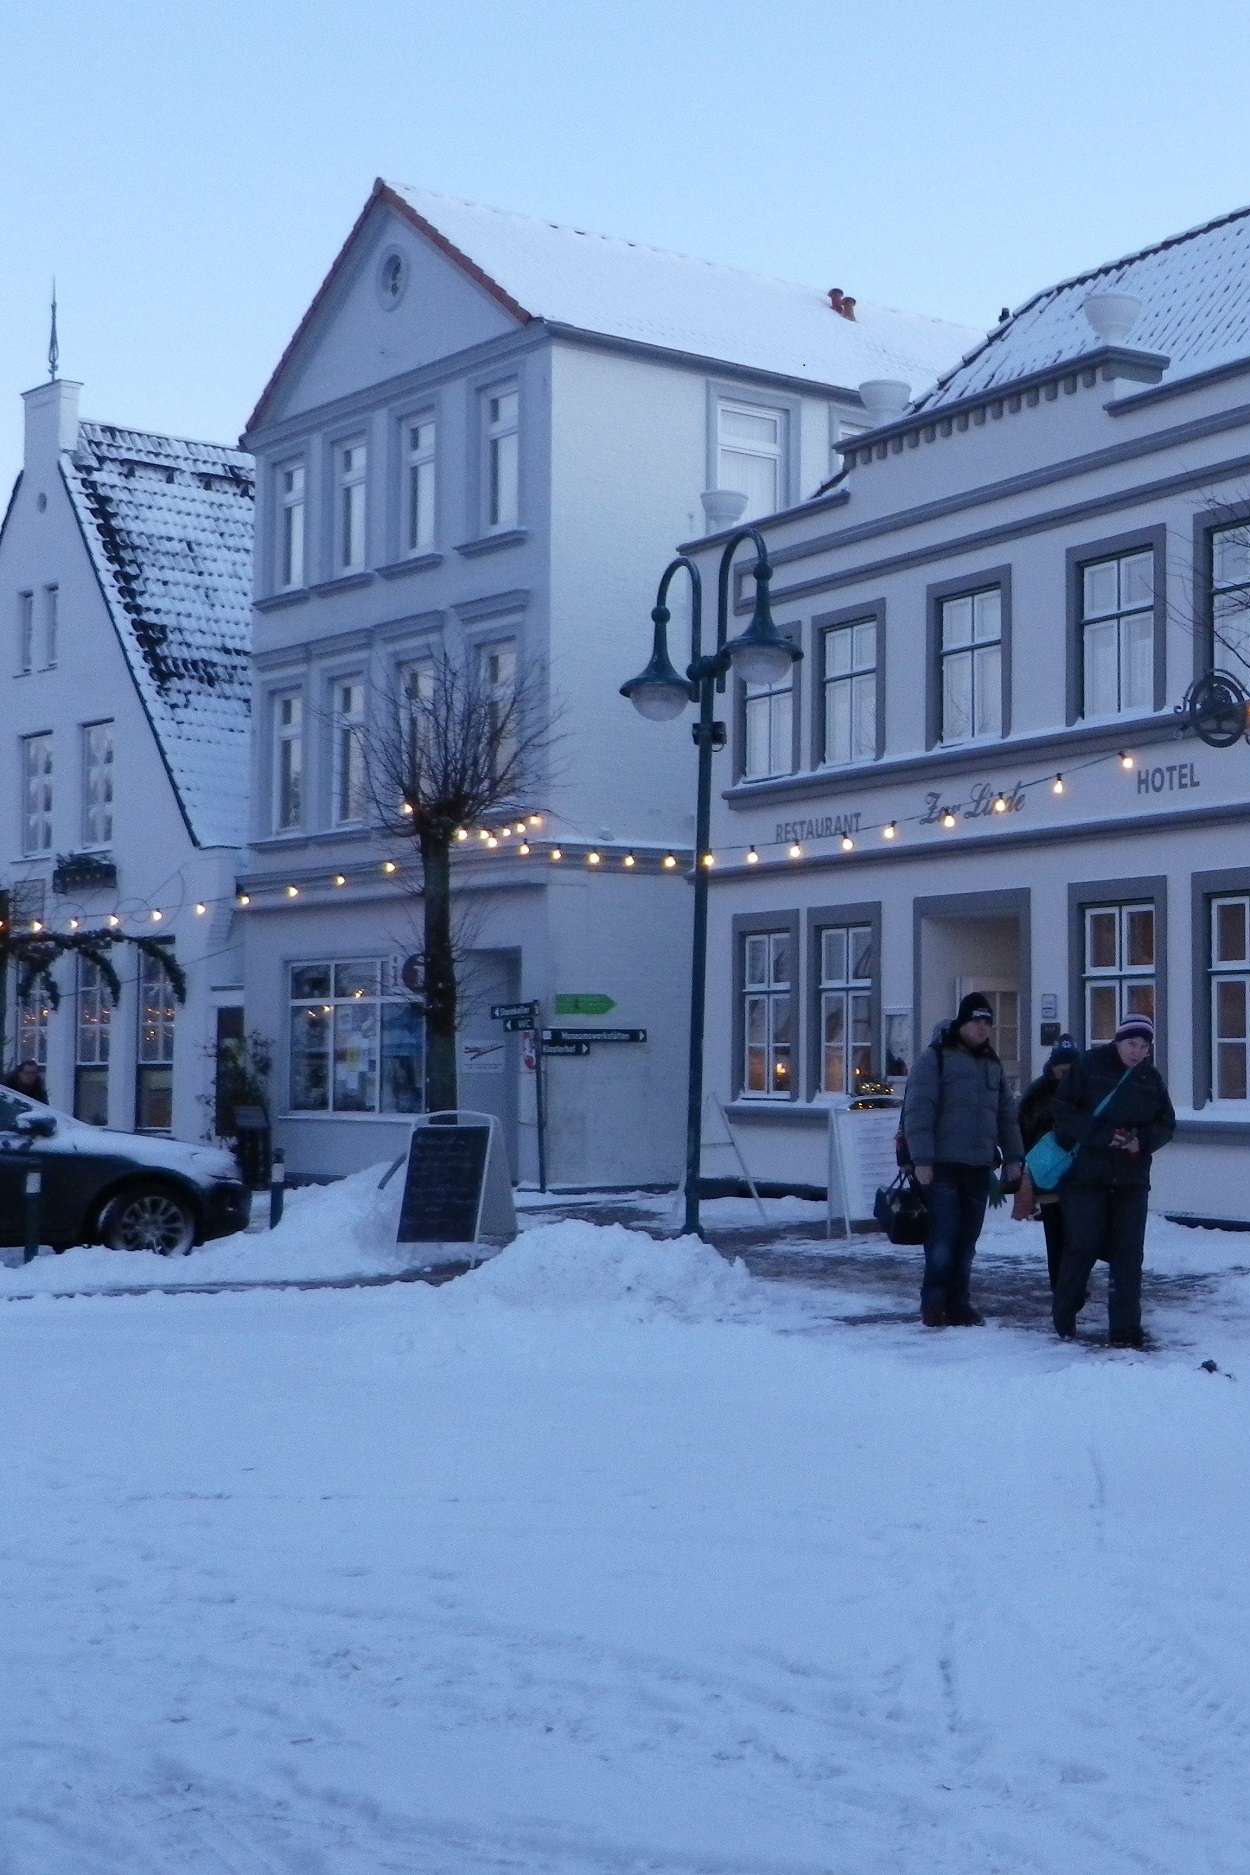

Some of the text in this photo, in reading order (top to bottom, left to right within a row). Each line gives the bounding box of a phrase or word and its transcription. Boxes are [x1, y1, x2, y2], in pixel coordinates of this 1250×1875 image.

[1137, 763, 1200, 795] HOTEL
[964, 780, 1026, 819] Lide
[776, 811, 862, 842] RESTAURANT
[517, 1019, 531, 1028] WC
